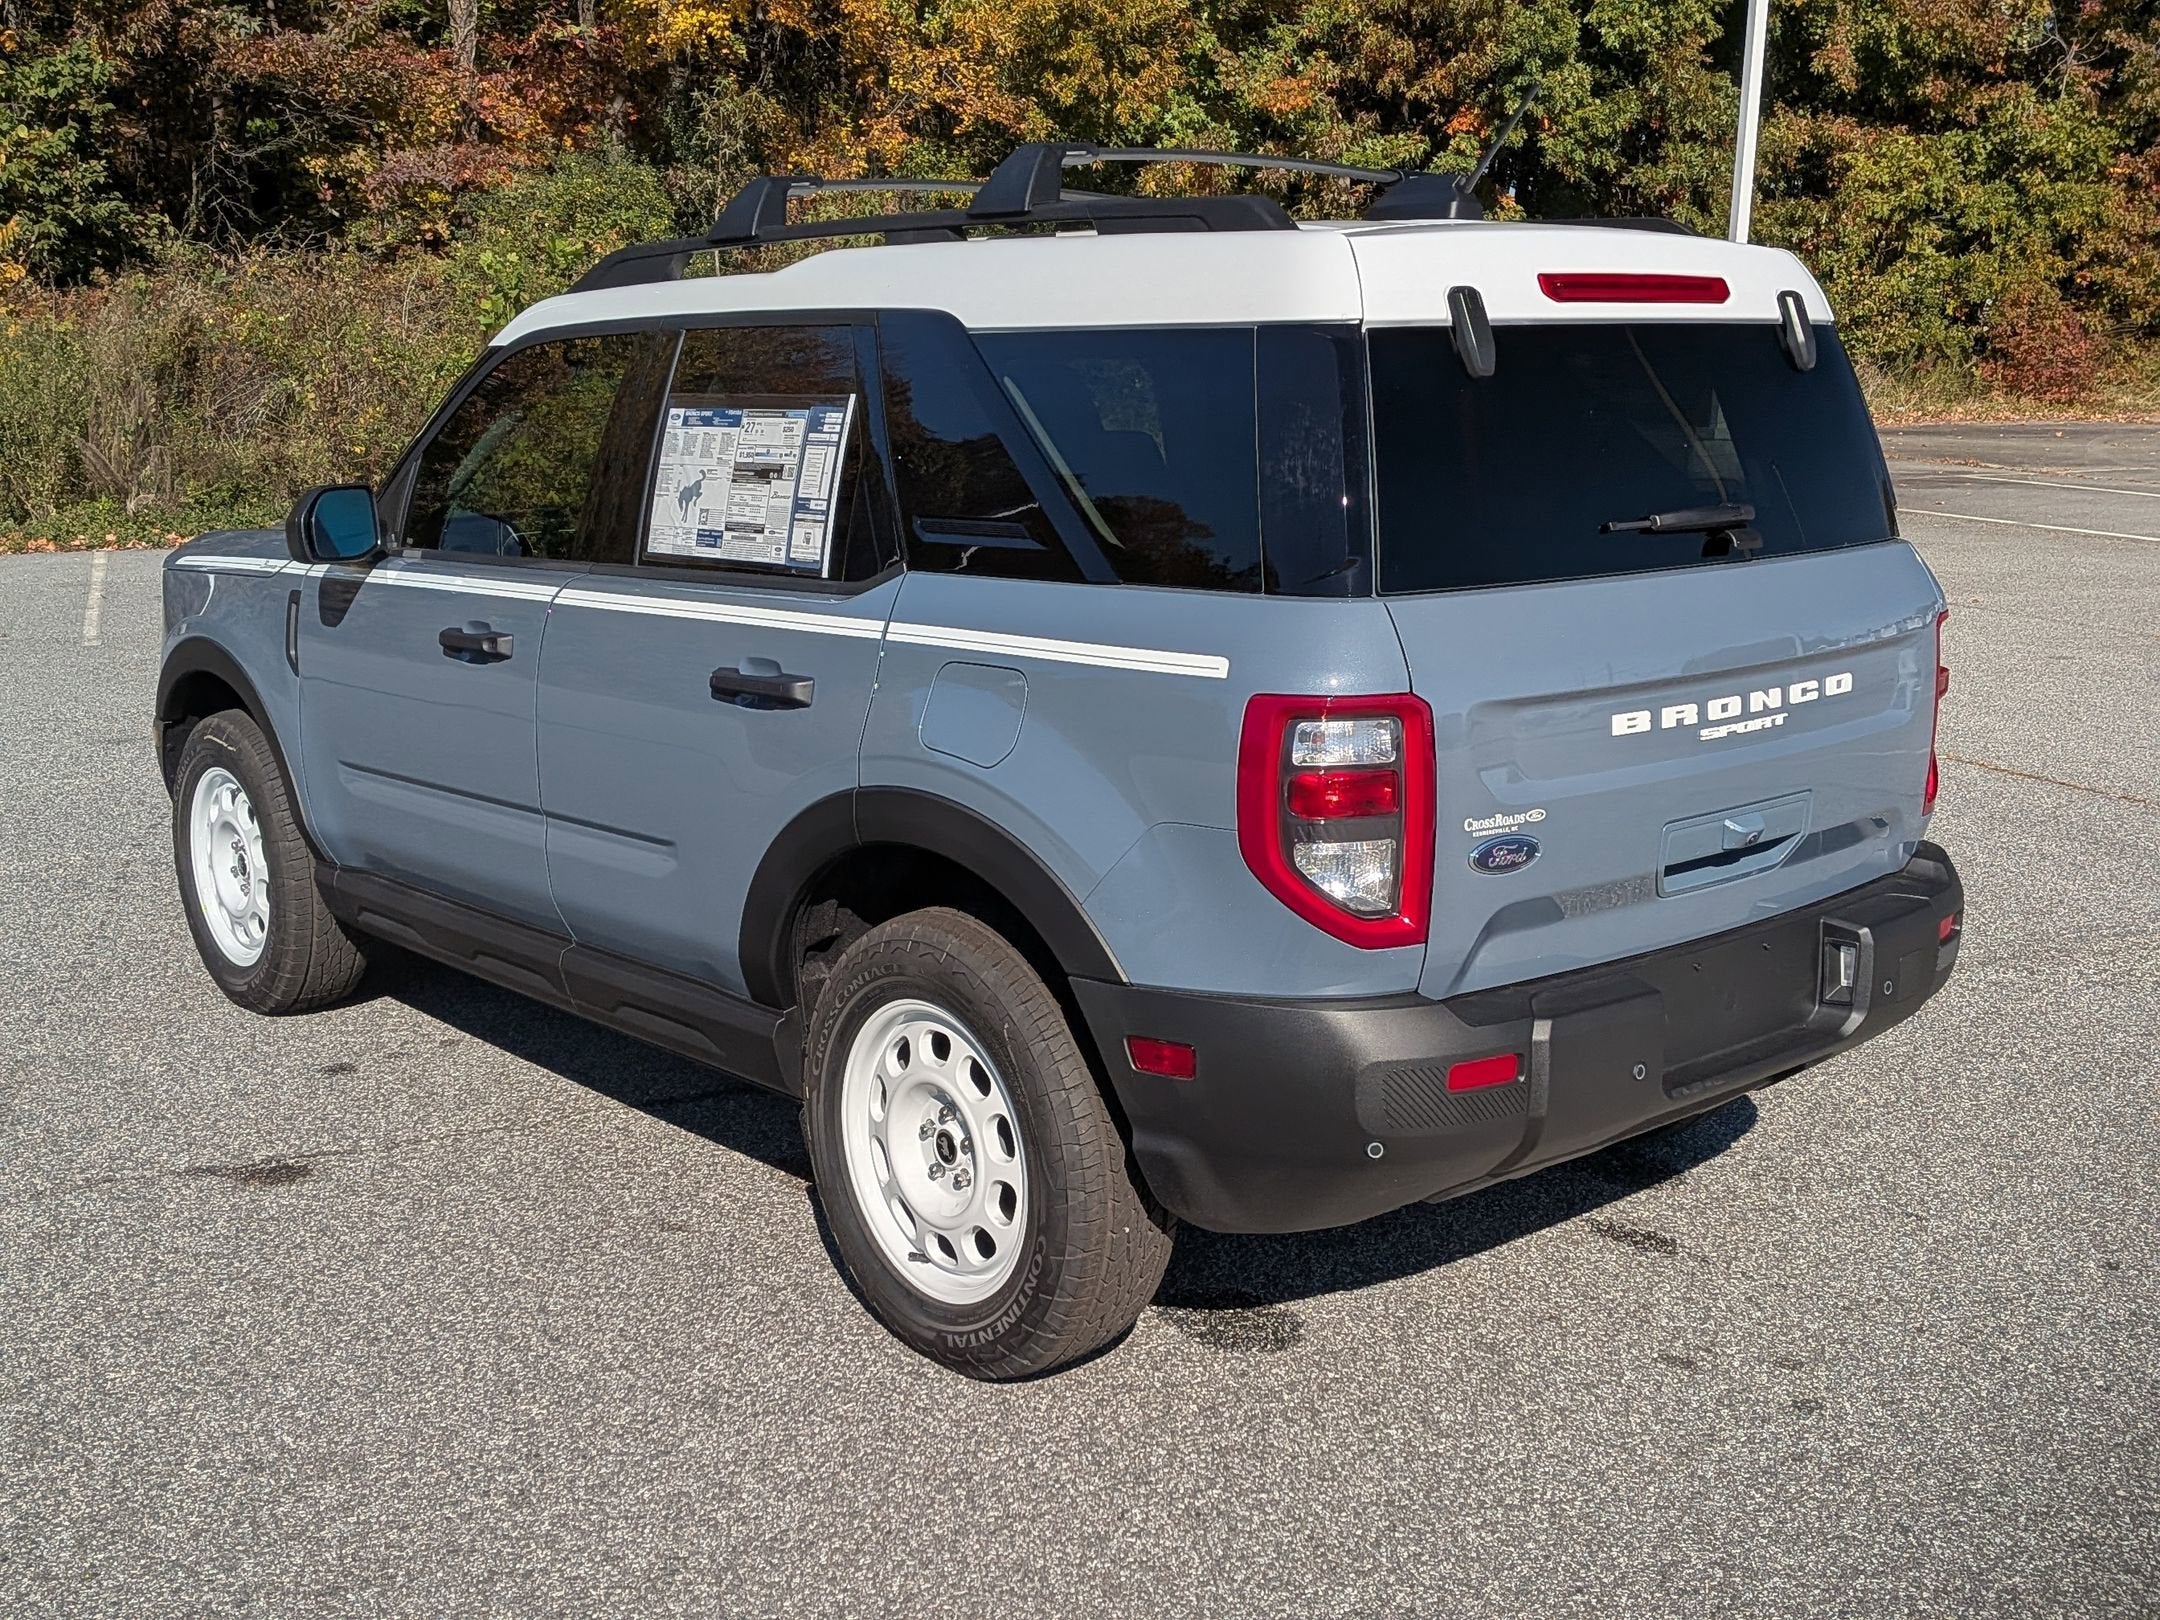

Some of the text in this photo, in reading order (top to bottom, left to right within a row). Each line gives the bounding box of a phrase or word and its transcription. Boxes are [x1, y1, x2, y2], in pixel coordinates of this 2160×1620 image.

[744, 421, 756, 433] 27
[1612, 672, 1853, 737] BRONCO
[1698, 713, 1788, 741] SPORT
[1488, 844, 1528, 868] Ford
[940, 1235, 1047, 1348] CONTINENTAL
